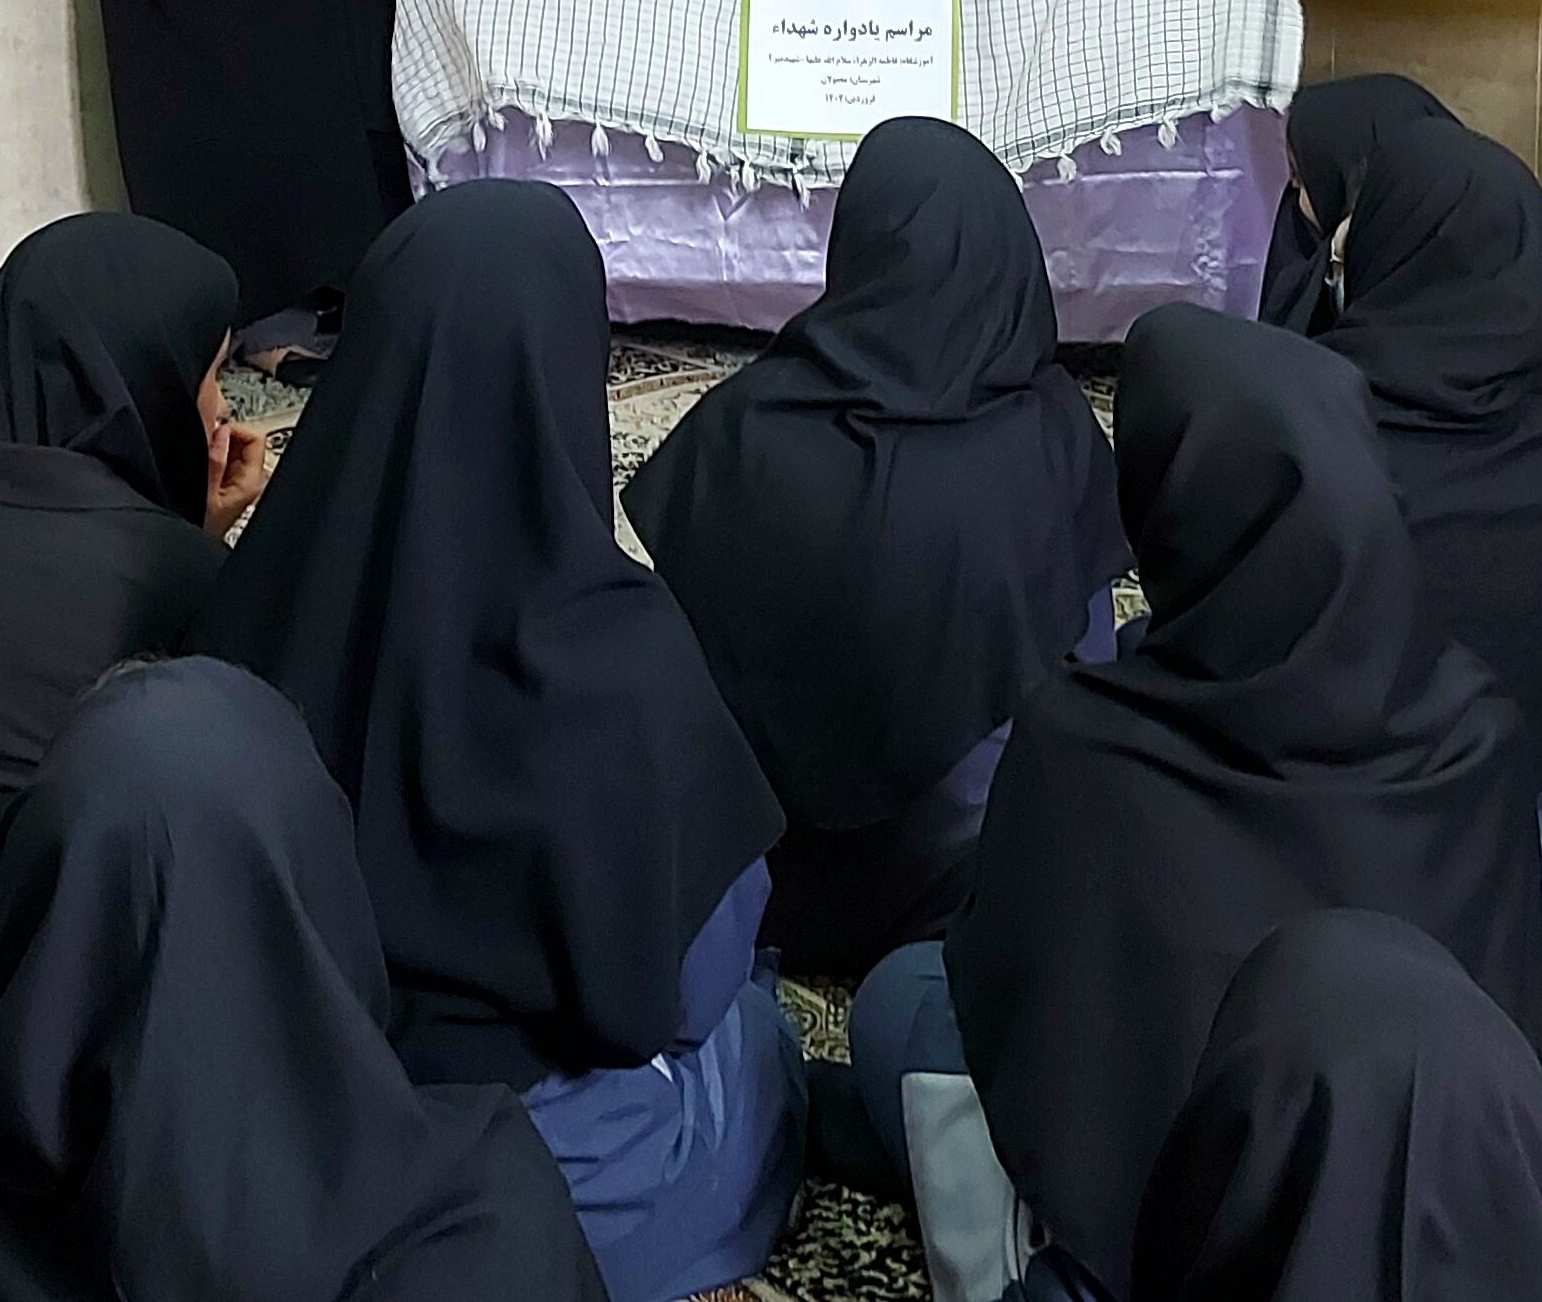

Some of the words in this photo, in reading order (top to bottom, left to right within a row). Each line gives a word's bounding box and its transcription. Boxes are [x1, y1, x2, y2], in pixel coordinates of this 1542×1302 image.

[772, 17, 819, 40] شهداء
[823, 18, 880, 42] یادواره
[885, 18, 933, 43] مراسم
